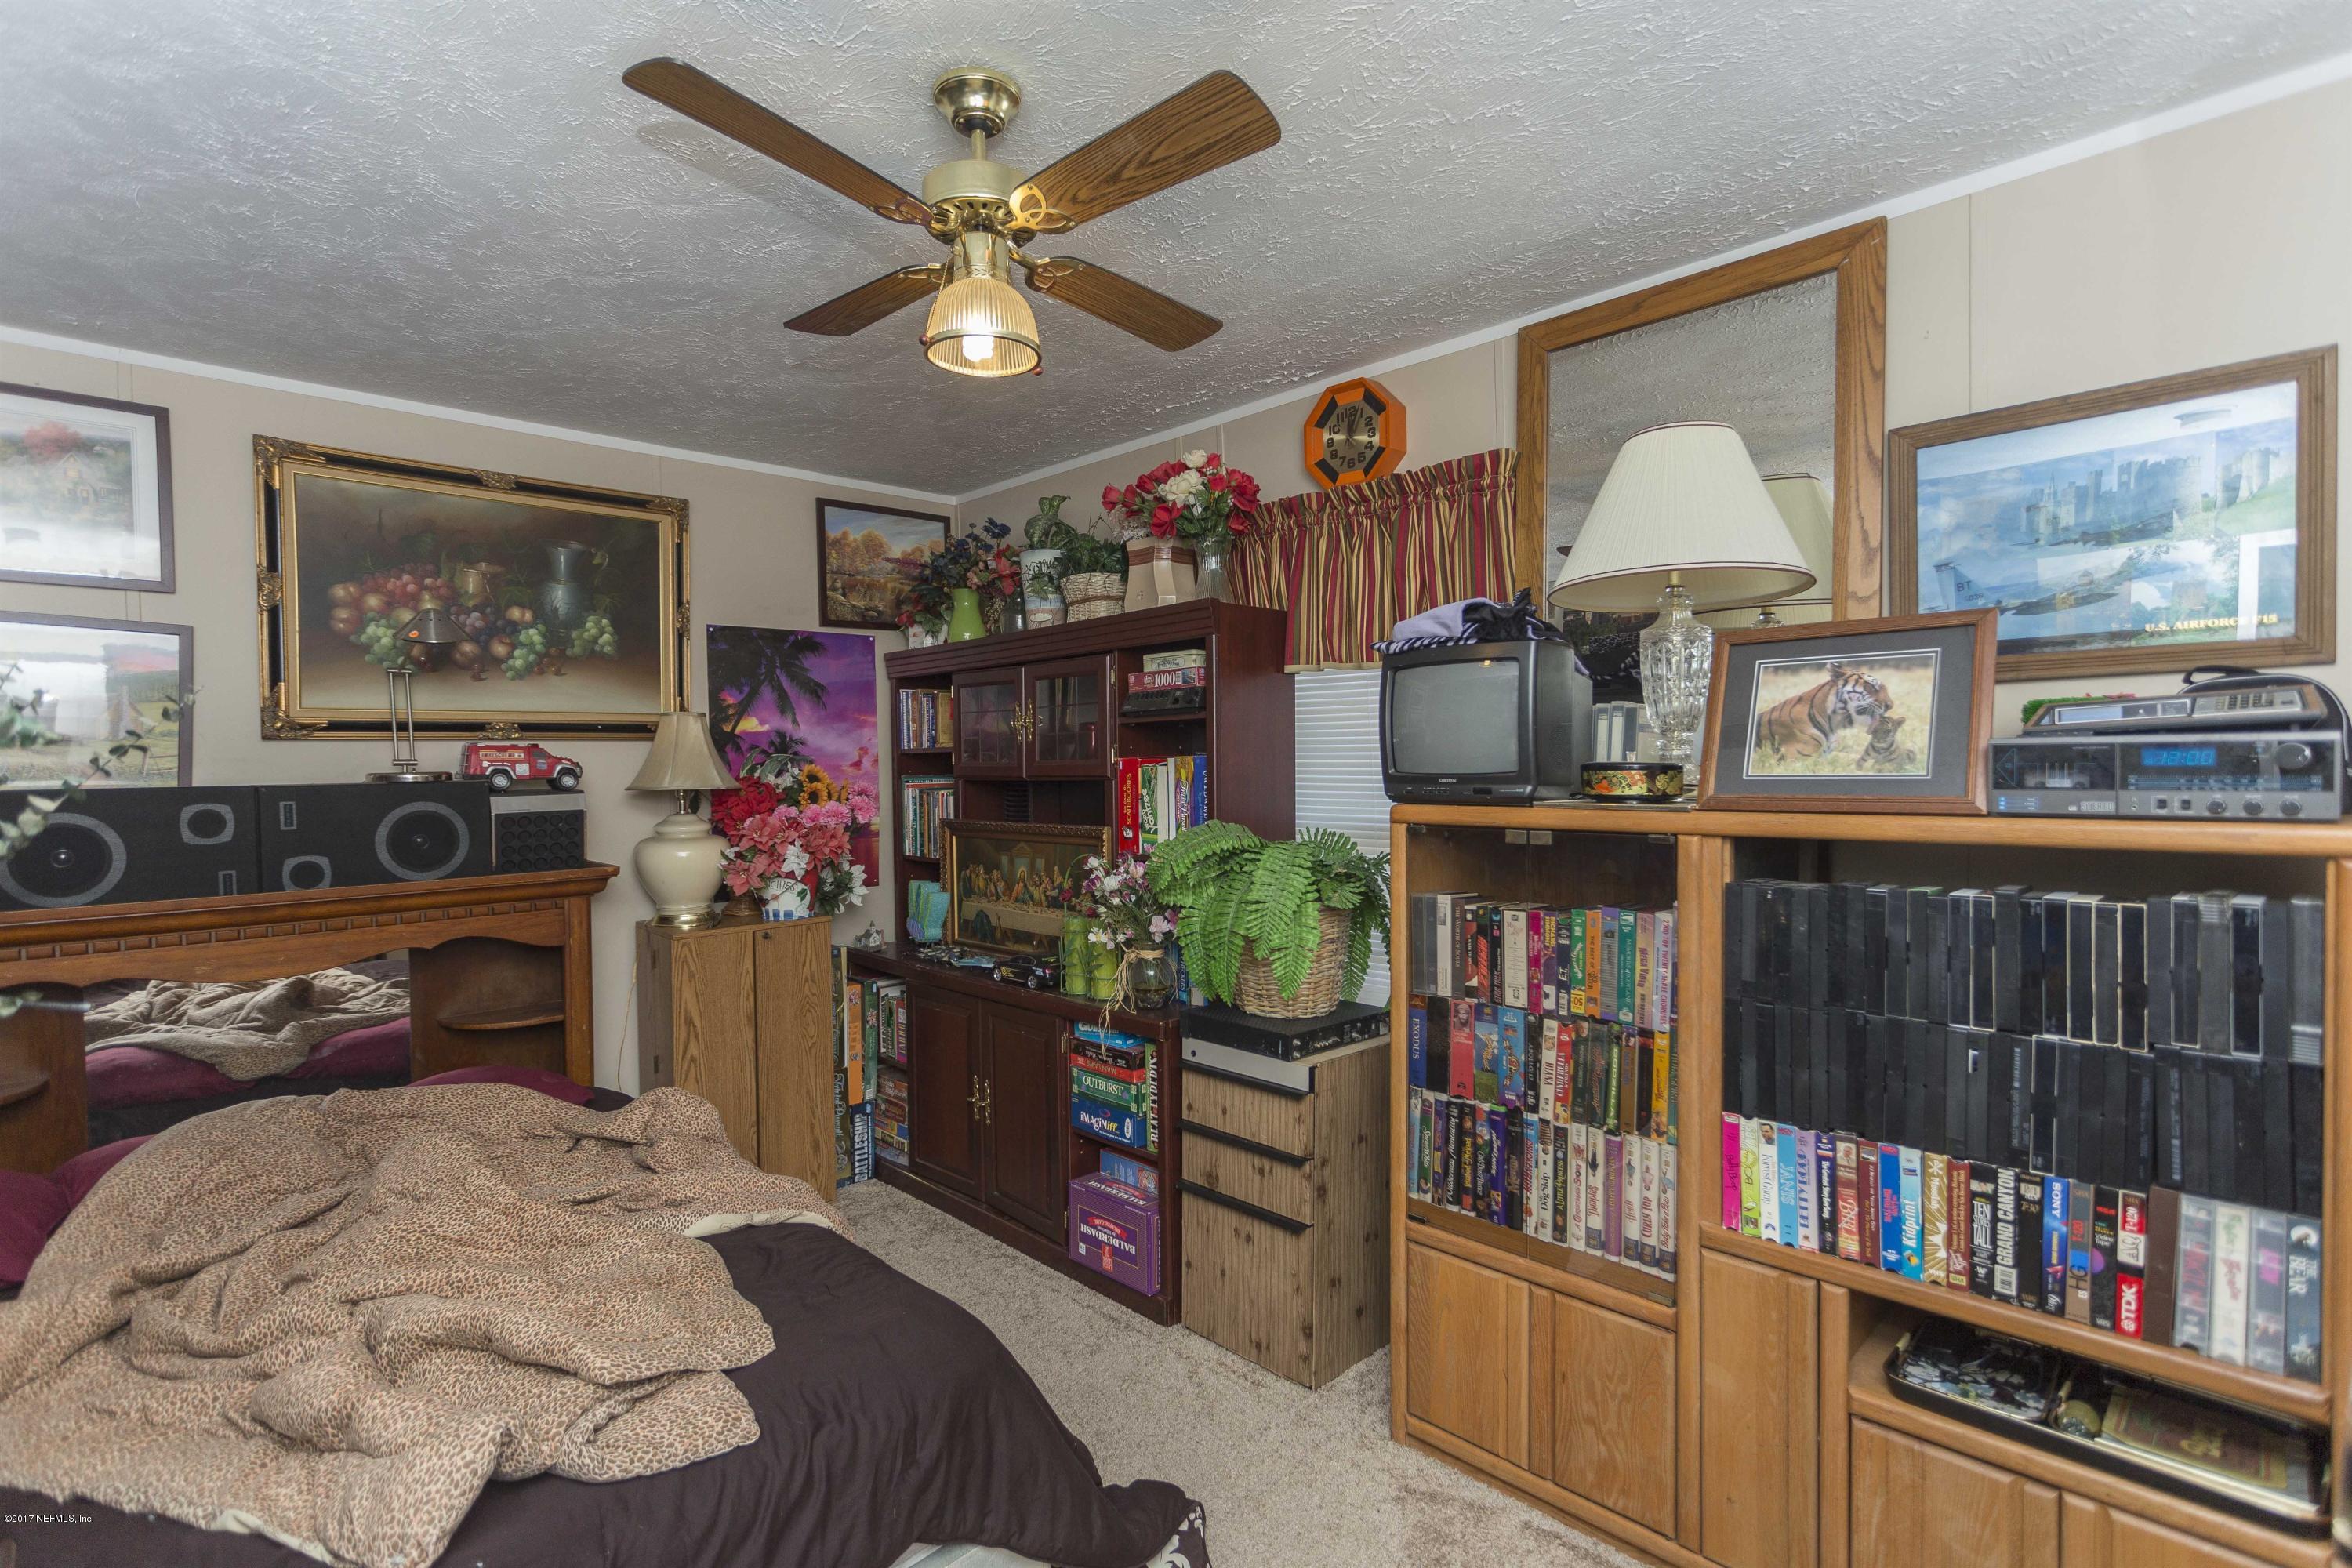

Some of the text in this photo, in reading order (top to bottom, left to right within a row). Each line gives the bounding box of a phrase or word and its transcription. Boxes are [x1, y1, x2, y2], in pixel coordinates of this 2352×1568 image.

[1328, 423, 1341, 436] 10
[1364, 416, 1374, 427] 2
[1367, 427, 1377, 438] 3
[1326, 437, 1334, 448] 9
[1330, 449, 1338, 460] 8
[1364, 440, 1374, 452] 4
[1338, 456, 1346, 467] 7
[1347, 458, 1356, 469] 6
[1357, 452, 1366, 463] 5
[1154, 672, 1175, 687] 1000
[1142, 788, 1158, 833] Yahtzee
[1180, 779, 1189, 832] Trivial Pursuit
[1559, 967, 1569, 981] E.T.
[1083, 1075, 1124, 1097] OUTBURST
[1555, 1053, 1565, 1097] CINDERELLA
[1610, 1048, 1618, 1116] GODZILLA
[854, 1113, 869, 1182] BATTLESHIP
[1573, 1161, 1581, 1187] STORY
[1821, 1160, 1830, 1169] The
[1726, 1171, 1737, 1190] Boop
[1761, 1153, 1773, 1205] Forrest Gump
[1780, 1163, 1795, 1206] JANIS
[1821, 1169, 1830, 1186] Greatest
[1089, 1181, 1147, 1206] BALDERDASH
[1541, 1172, 1551, 1211] Dog Skip
[1821, 1186, 1831, 1197] Story
[1823, 1197, 1831, 1207] Ever
[1930, 1178, 1939, 1210] Messiah
[2051, 1182, 2063, 1218] SONY
[1641, 1196, 1652, 1238] CURLY TOP
[1798, 1185, 1809, 1229] BETTY
[1973, 1200, 1991, 1221] TEN
[1996, 1168, 2015, 1266] GRAND CANYON
[2125, 1207, 2140, 1232] T-120
[1661, 1196, 1671, 1249] Baby Take Bow
[1902, 1200, 1915, 1247] Kidprint
[1080, 1223, 1136, 1254] BALDERDASH
[1973, 1224, 1993, 1248] TALL
[2095, 1233, 2114, 1243] Video
[2070, 1265, 2088, 1290] HG
[2288, 1256, 2307, 1294] BEAR
[2121, 1285, 2136, 1317] TDK
